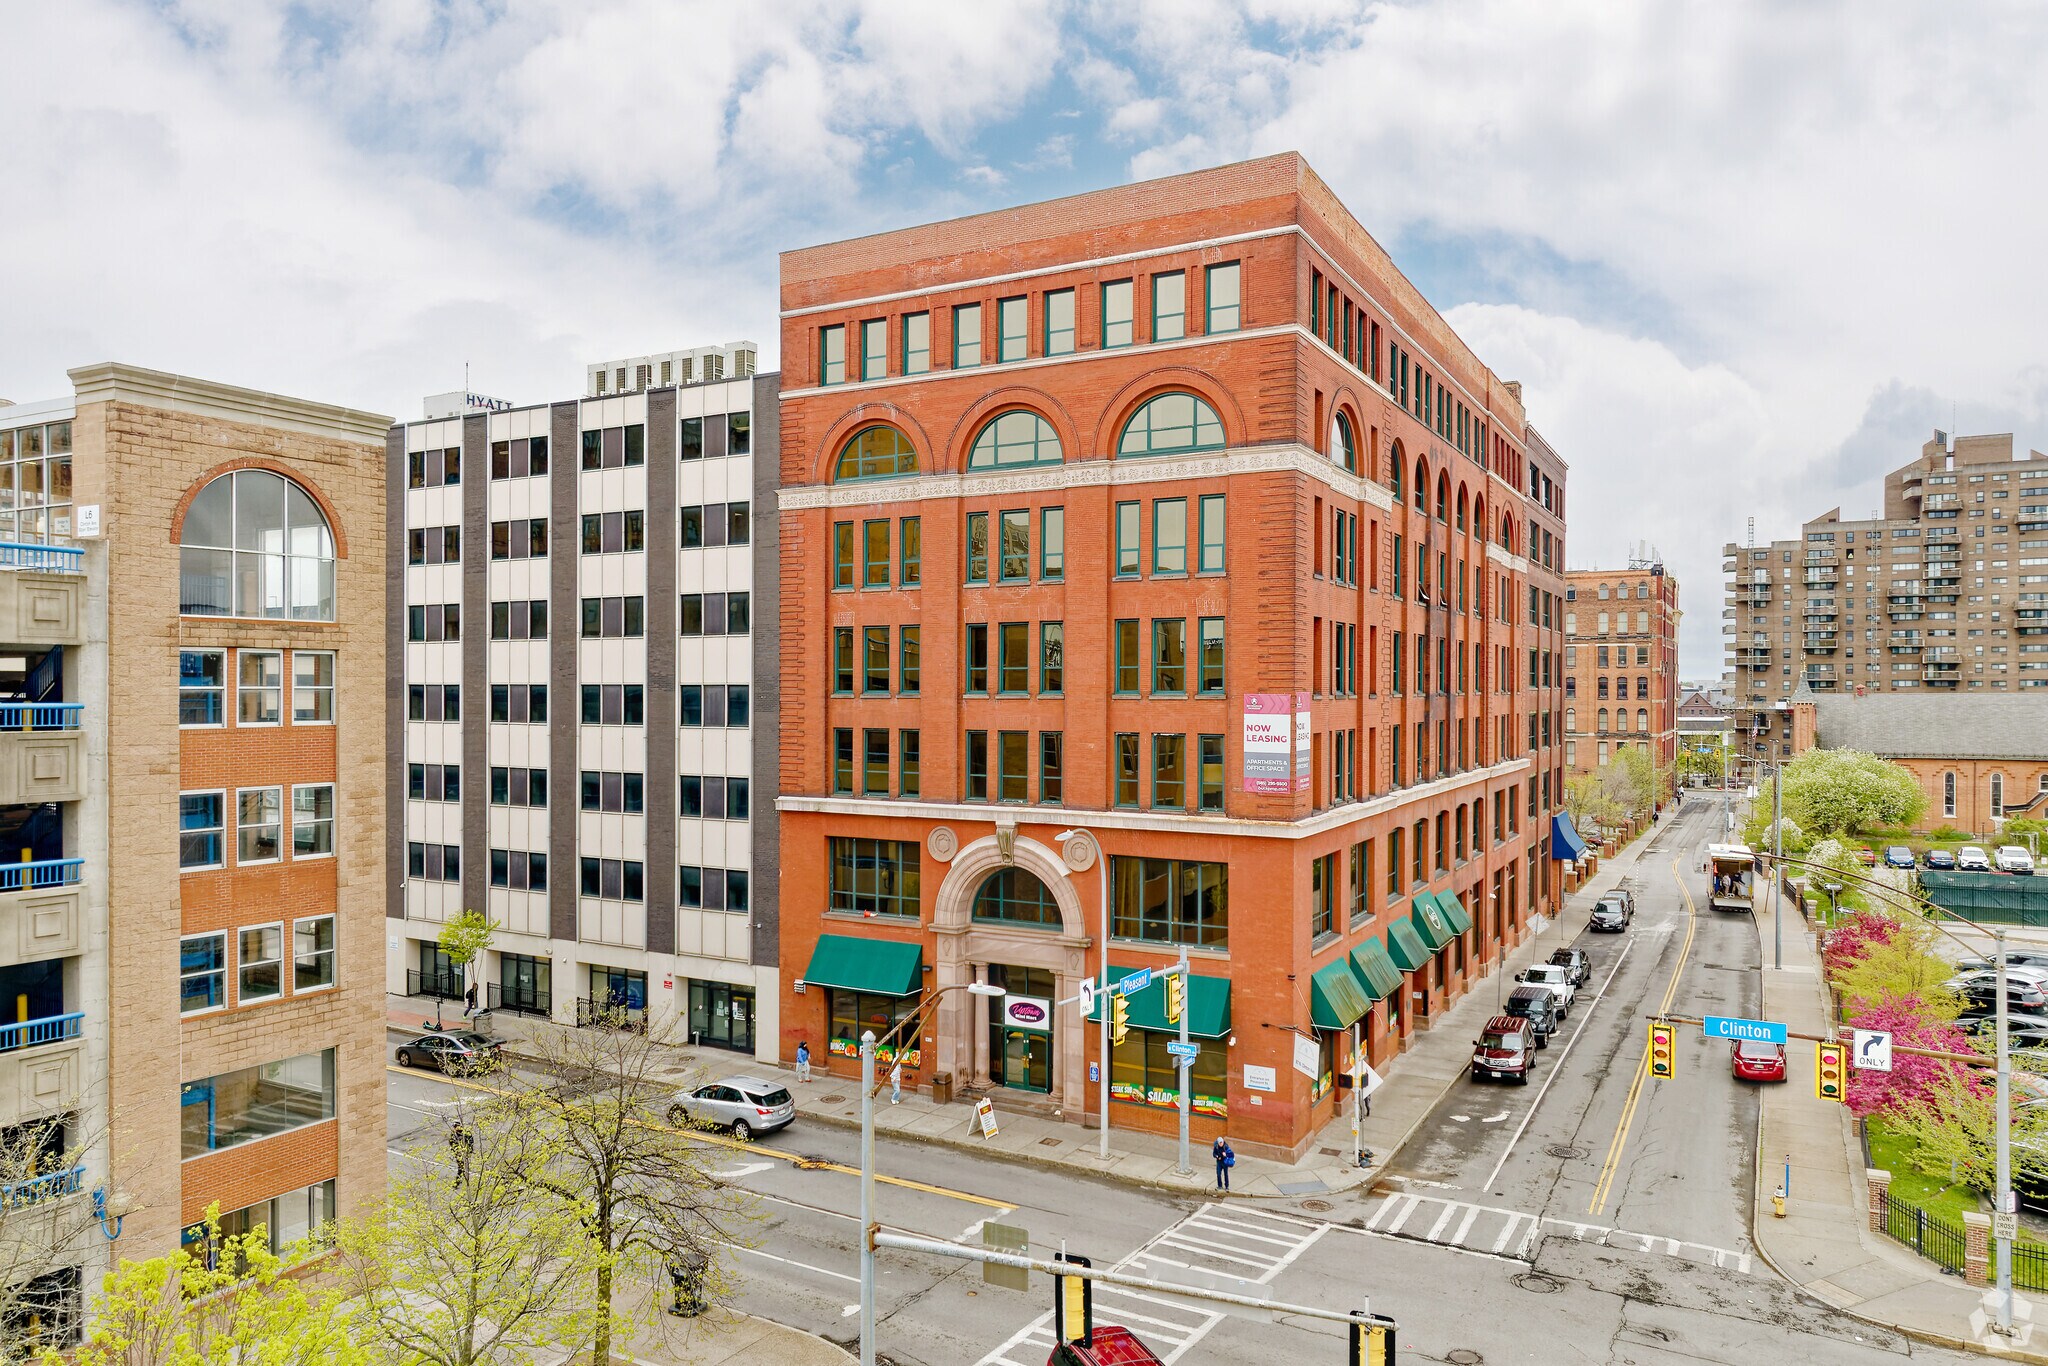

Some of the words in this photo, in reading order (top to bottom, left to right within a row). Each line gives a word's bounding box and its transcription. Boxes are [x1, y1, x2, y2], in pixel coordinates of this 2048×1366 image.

[466, 394, 512, 411] HYATT
[85, 510, 92, 519] L6
[1246, 724, 1271, 732] NOW
[1246, 734, 1287, 743] LEASING
[1124, 972, 1147, 992] Pleasant
[1012, 1005, 1040, 1016] Uptown
[1082, 1002, 1092, 1012] ONLY
[1719, 1020, 1771, 1039] Clinton
[1171, 1044, 1191, 1053] Clinton
[1859, 1057, 1885, 1067] ONLY
[1147, 1090, 1172, 1103] SALAD
[1996, 1222, 2014, 1230] CROSS
[1998, 1229, 2012, 1237] HERE
